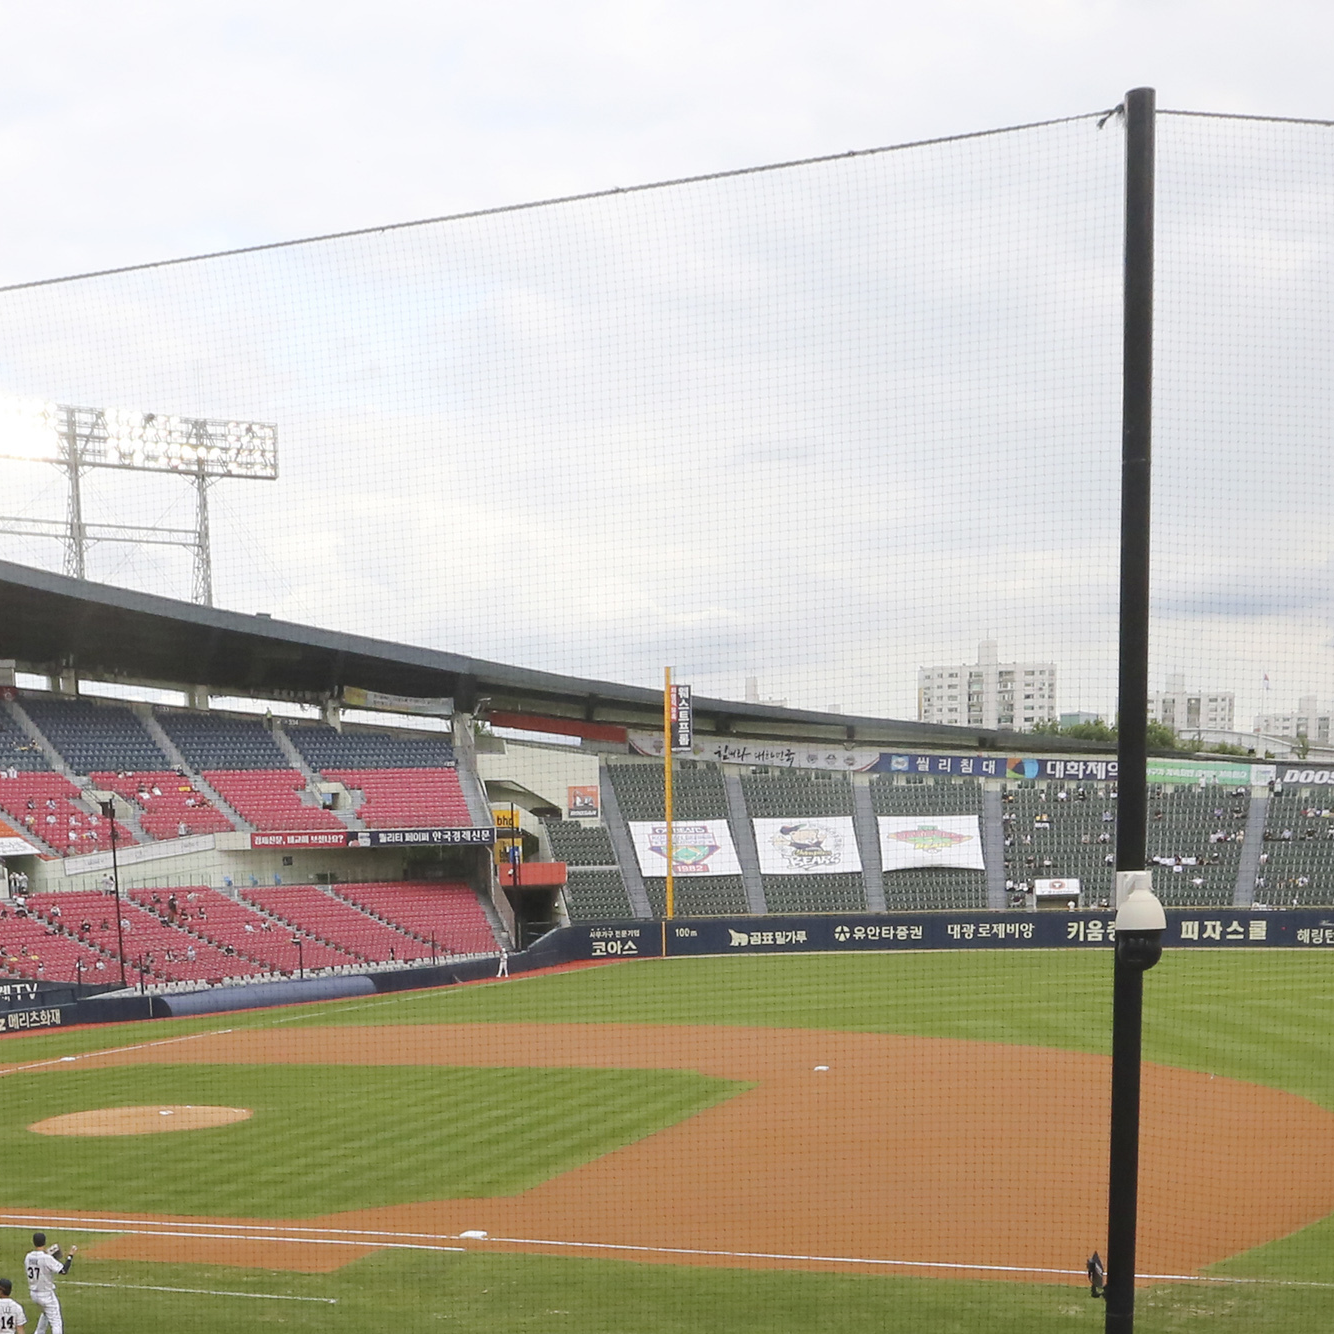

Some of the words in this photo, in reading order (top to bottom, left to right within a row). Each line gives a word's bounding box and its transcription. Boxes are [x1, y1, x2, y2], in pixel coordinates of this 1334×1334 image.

[673, 864, 709, 873] 1982
[675, 927, 698, 938] 100m
[853, 924, 924, 940] 유안타증권
[1180, 920, 1268, 941] 피자스쿨
[591, 940, 639, 957] 코아스
[7, 1007, 62, 1031] 메리츠화재
[28, 1267, 40, 1280] 37
[1, 1315, 14, 1330] 14
